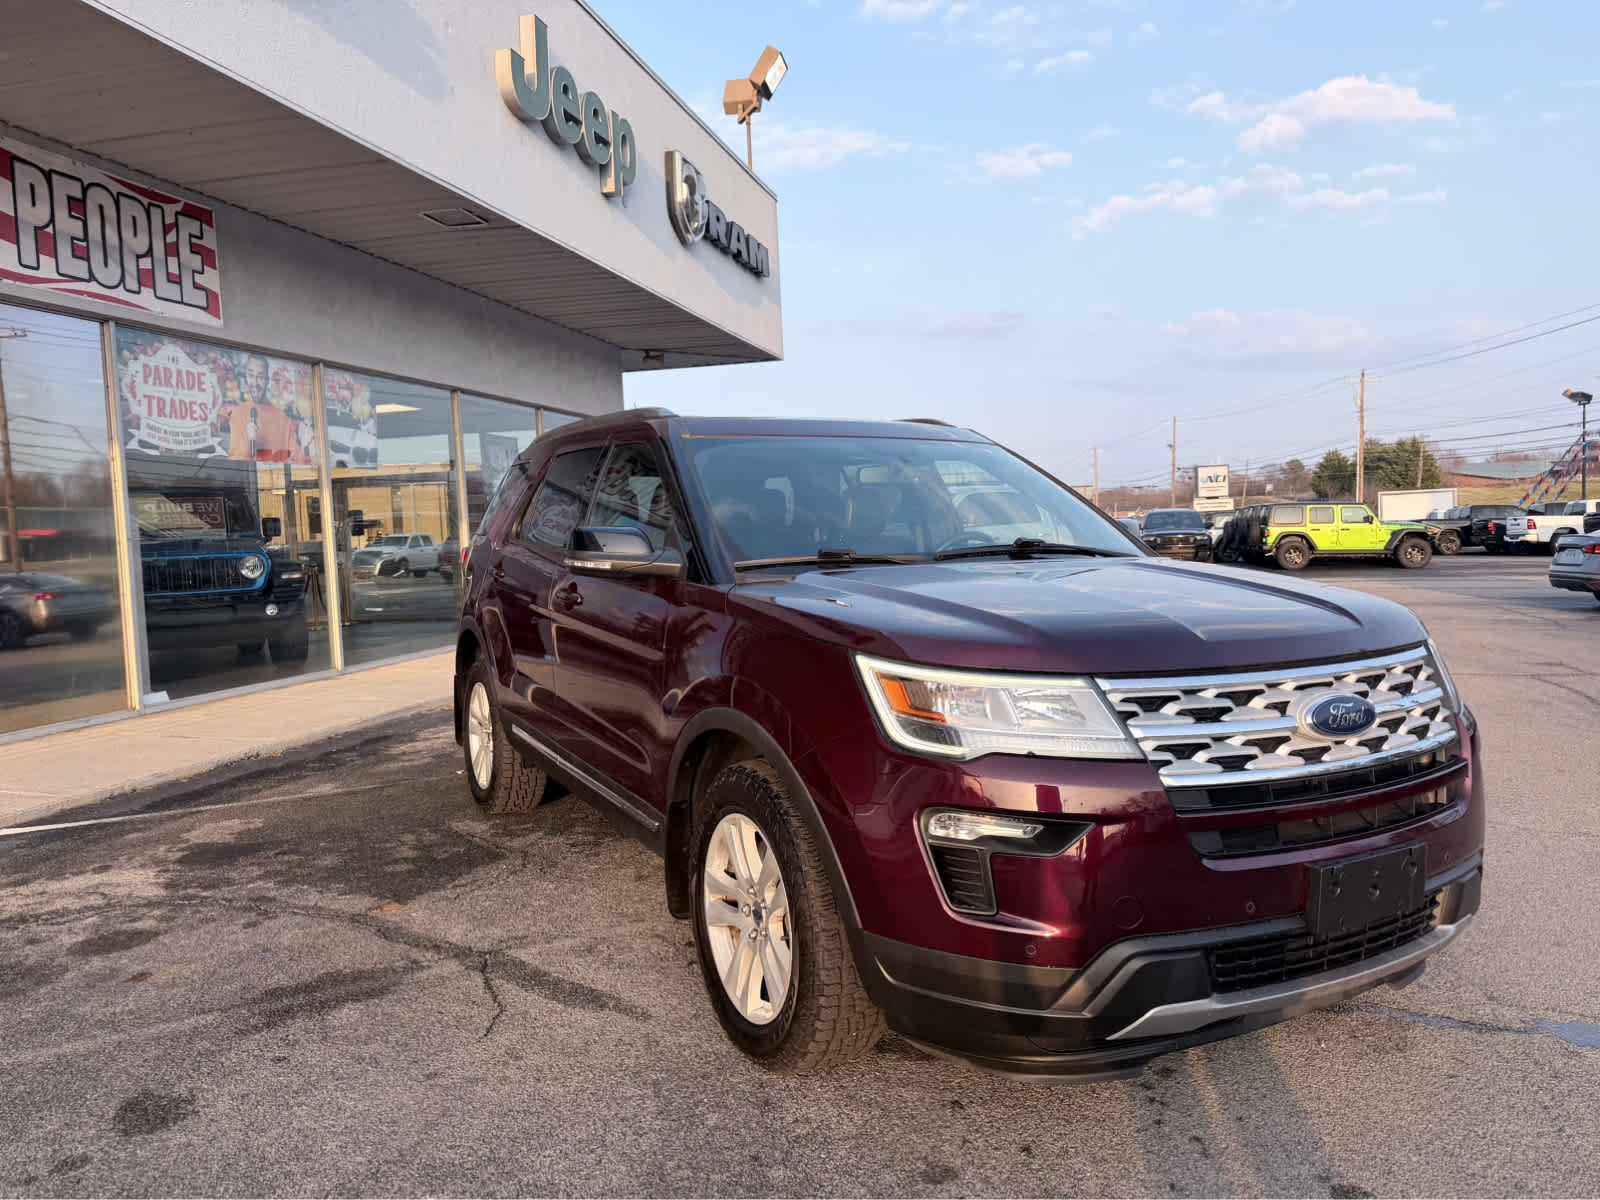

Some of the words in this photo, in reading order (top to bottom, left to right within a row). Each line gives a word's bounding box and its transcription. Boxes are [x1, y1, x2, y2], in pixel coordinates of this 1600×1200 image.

[495, 14, 636, 199] Jeep
[10, 156, 210, 310] PEOPLE
[704, 199, 770, 277] RAM
[142, 362, 207, 393] PARADE
[143, 393, 209, 422] TRADES
[1328, 702, 1368, 729] Ford
